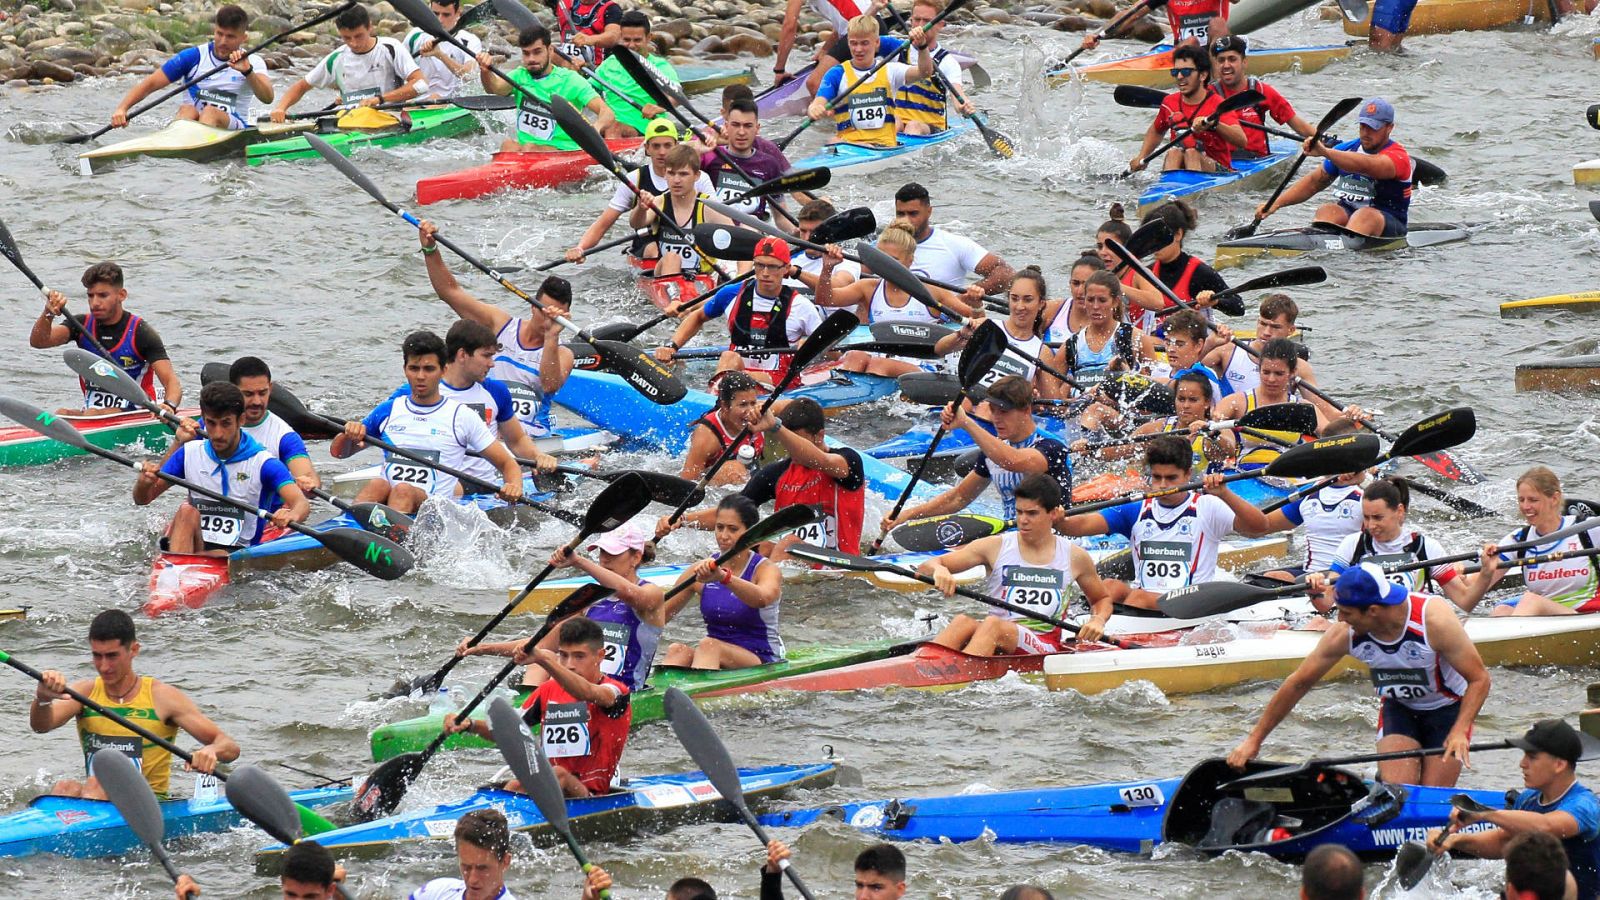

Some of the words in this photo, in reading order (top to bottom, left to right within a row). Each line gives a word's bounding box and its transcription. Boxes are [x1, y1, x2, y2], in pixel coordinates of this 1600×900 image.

[566, 45, 580, 56] 15
[853, 96, 884, 105] Liberbank
[522, 113, 549, 131] 183
[856, 107, 884, 122] 184
[722, 177, 753, 189] Liberba
[630, 372, 658, 396] DAVID
[511, 387, 536, 398] erbank
[94, 393, 124, 408] 206
[512, 400, 531, 416] 03
[392, 466, 429, 484] 222
[196, 504, 240, 514] Liberbank
[200, 516, 235, 534] 193
[797, 525, 819, 541] 04
[1144, 547, 1186, 557] Liberbank
[1013, 572, 1057, 584] Liberbank
[1146, 562, 1181, 579] 303
[1014, 589, 1053, 606] 320
[1196, 647, 1226, 659] Eagle
[1377, 672, 1423, 683] Liberbank
[1386, 686, 1426, 702] 130
[545, 708, 580, 719] berbank
[546, 725, 580, 744] 226
[1124, 787, 1155, 802] 130
